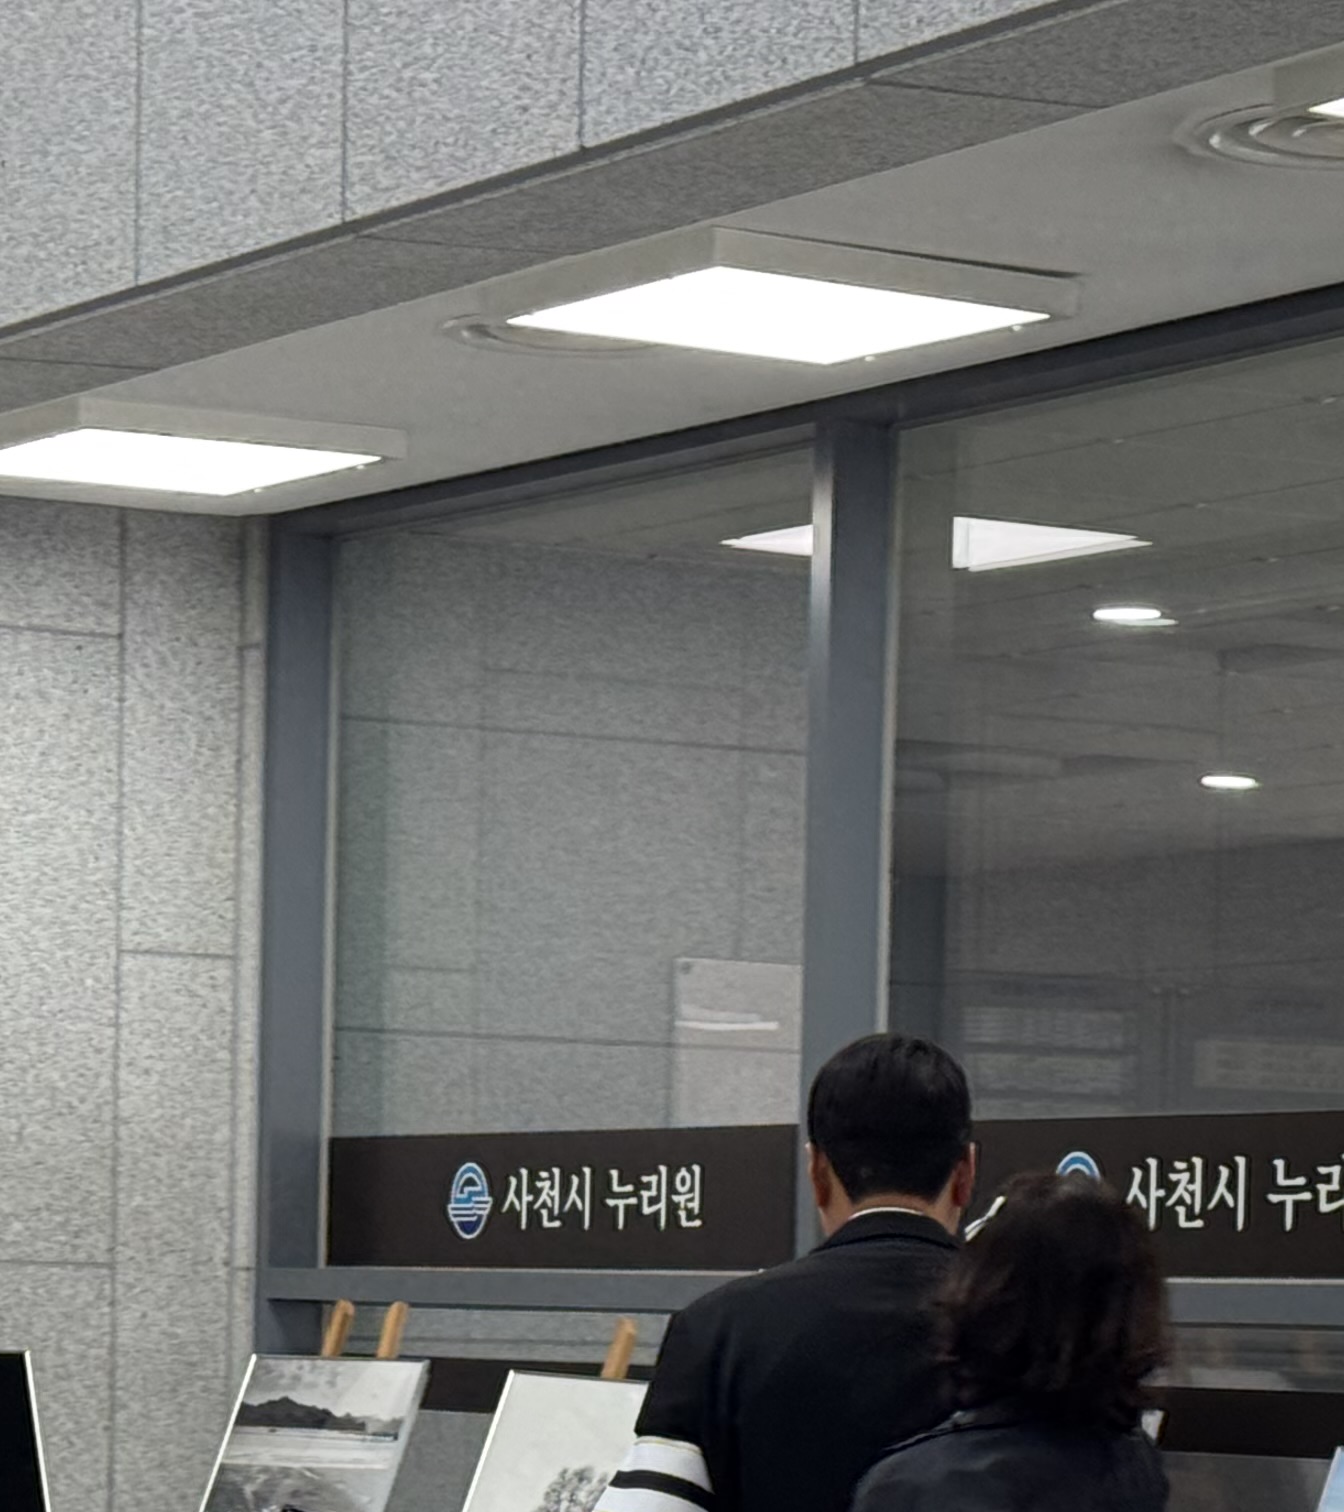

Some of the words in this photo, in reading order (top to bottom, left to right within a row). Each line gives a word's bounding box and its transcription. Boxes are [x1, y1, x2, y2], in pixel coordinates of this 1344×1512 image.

[501, 1166, 592, 1231] 사천시
[605, 1163, 703, 1231] 누리원
[1126, 1155, 1247, 1231] 사천시
